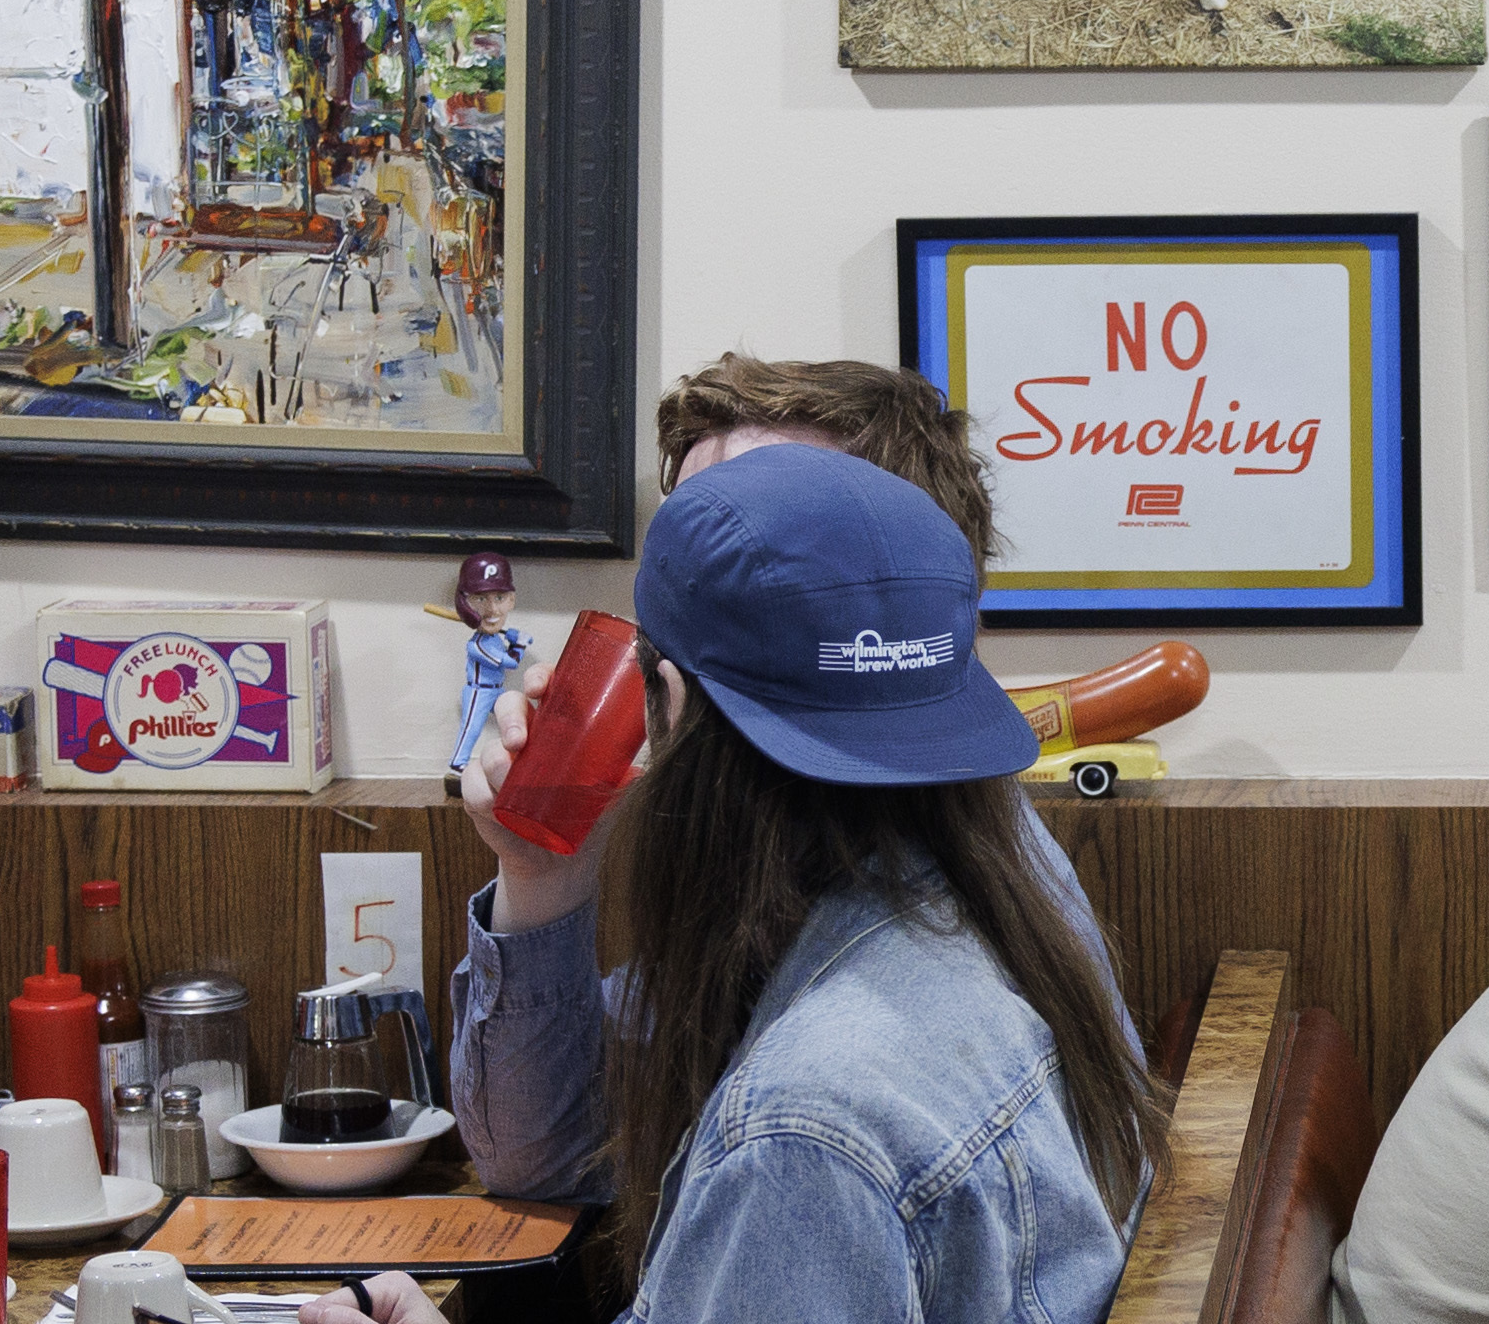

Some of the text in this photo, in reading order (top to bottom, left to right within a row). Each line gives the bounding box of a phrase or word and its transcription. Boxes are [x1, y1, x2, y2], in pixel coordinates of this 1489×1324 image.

[1105, 300, 1208, 372] NO
[996, 375, 1321, 476] Smoking
[122, 641, 219, 677] FREE LUNCH
[854, 654, 938, 673] brew works
[337, 901, 396, 977] 5
